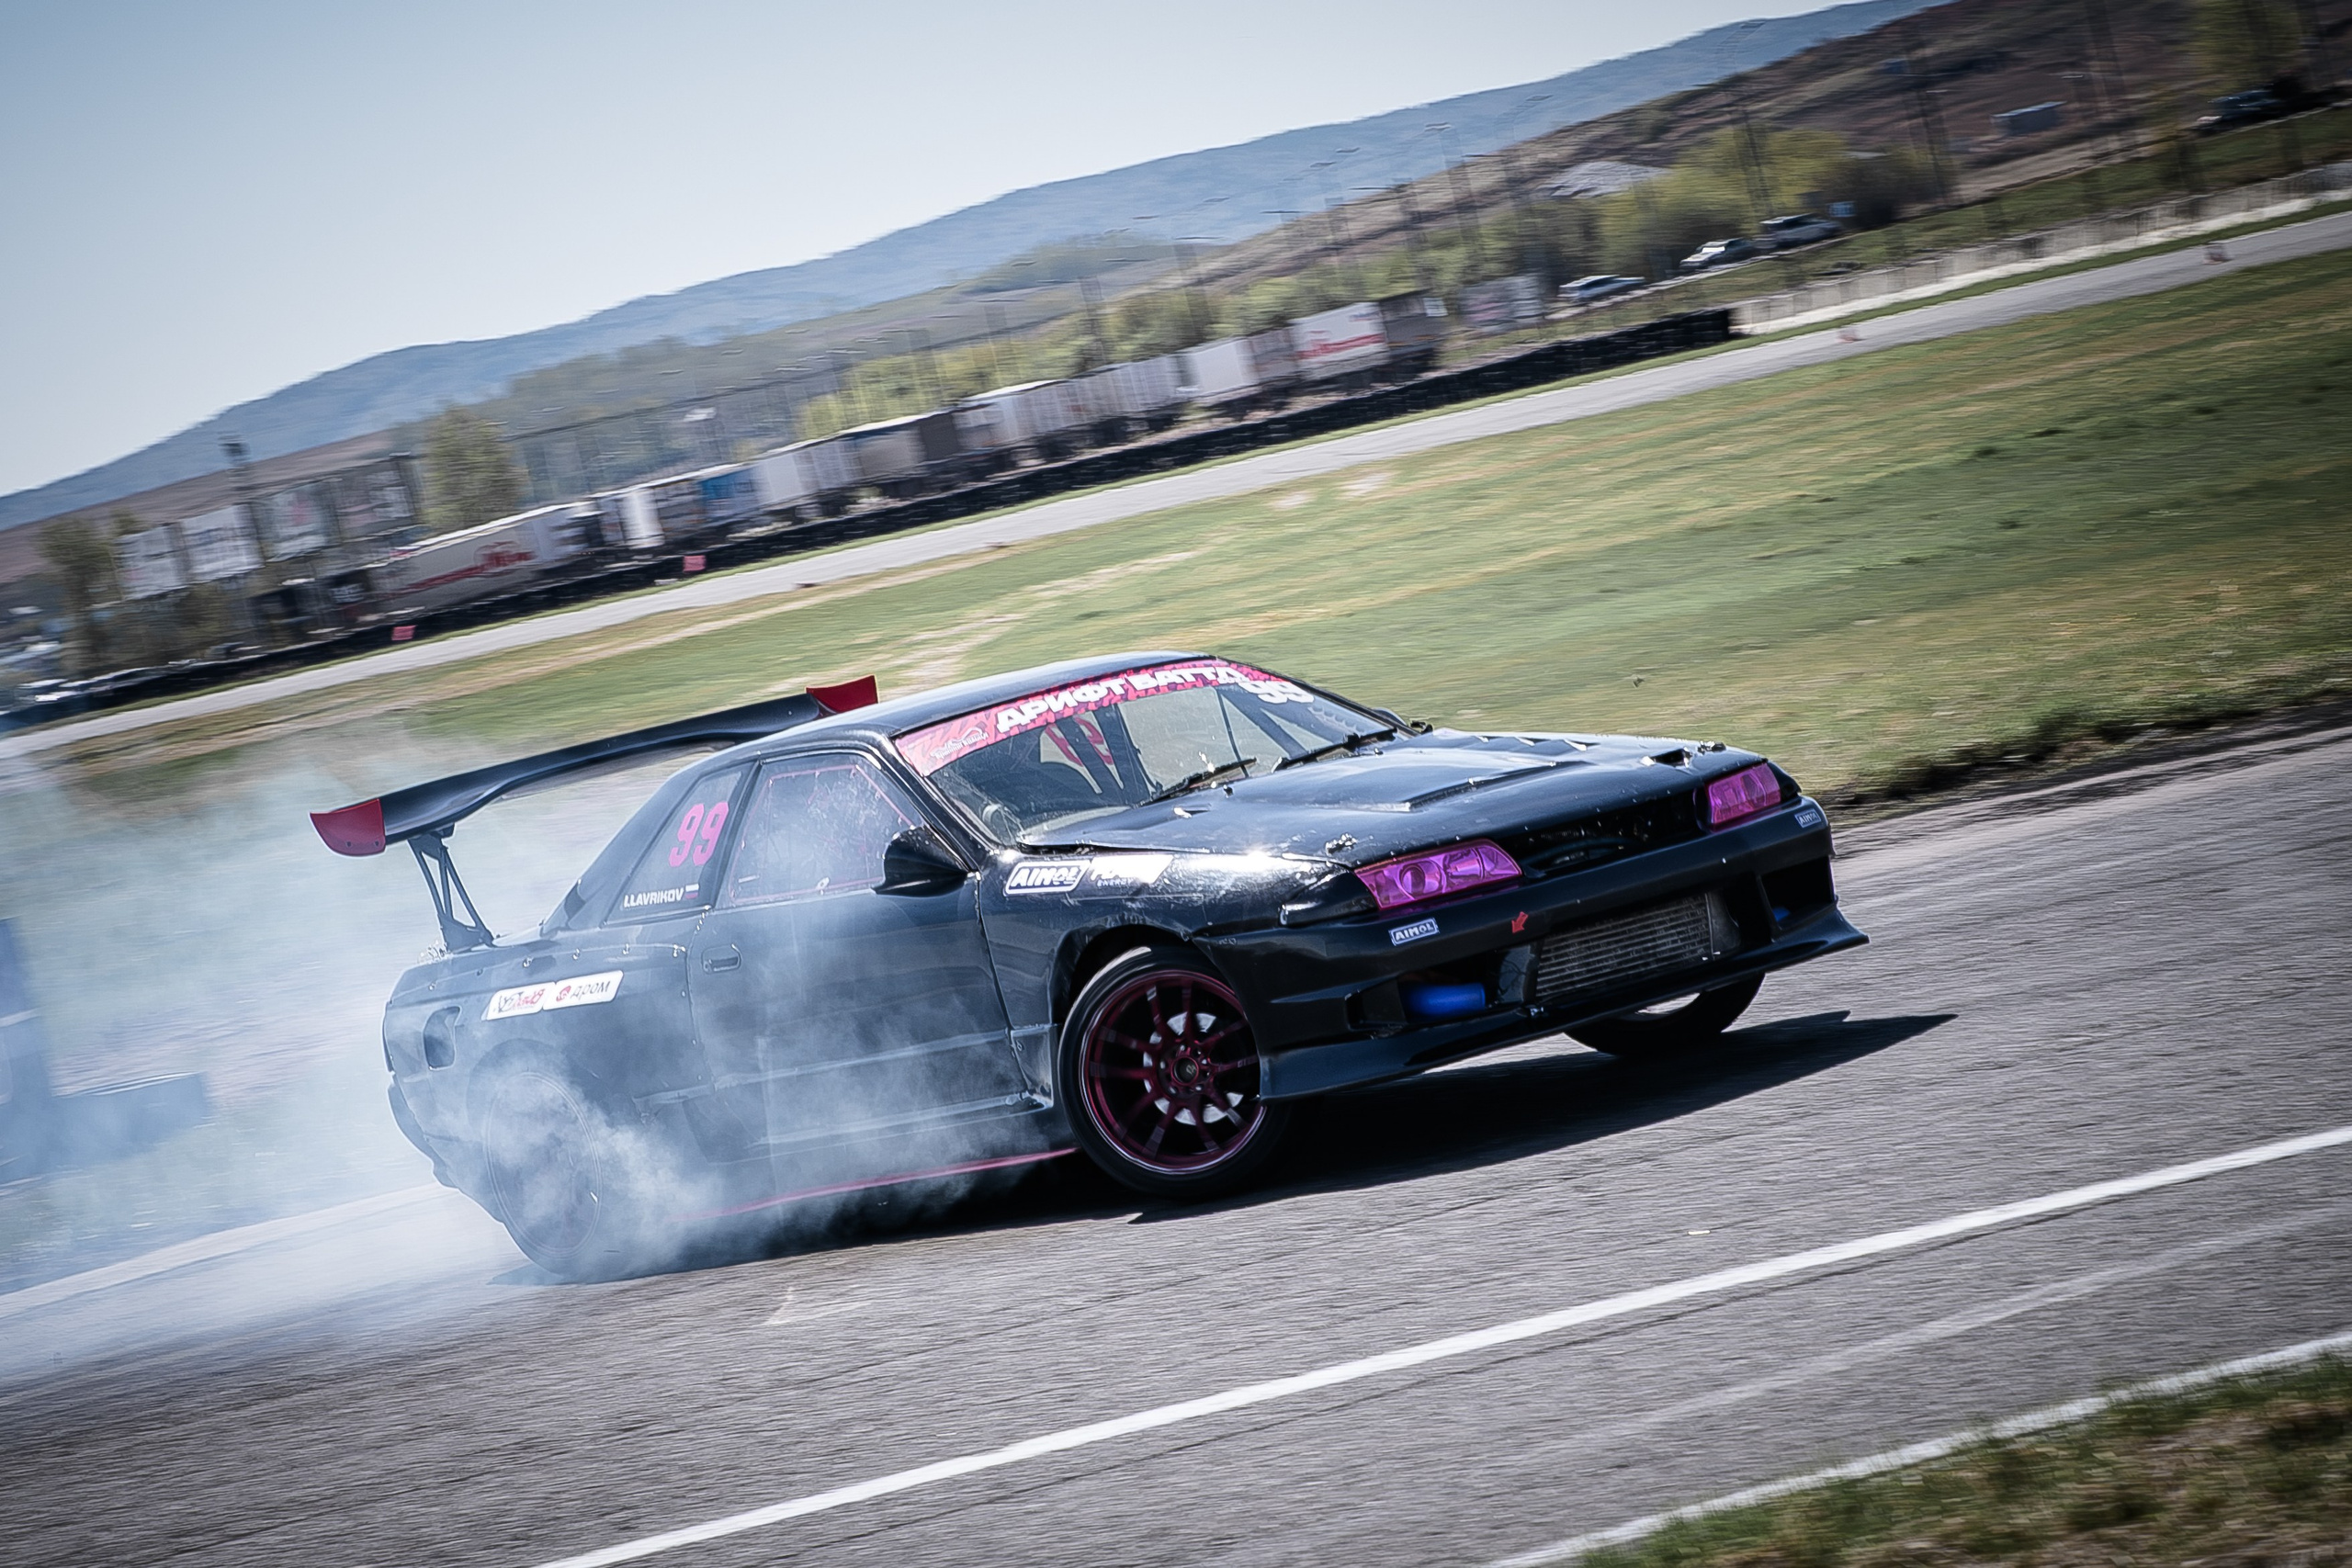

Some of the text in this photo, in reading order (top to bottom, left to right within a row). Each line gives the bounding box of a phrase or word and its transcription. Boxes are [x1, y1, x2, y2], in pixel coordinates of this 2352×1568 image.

[996, 677, 1126, 733] ДРИФТ
[1238, 680, 1315, 705] 99
[668, 802, 729, 867] 99
[1395, 922, 1434, 942] AIMOL
